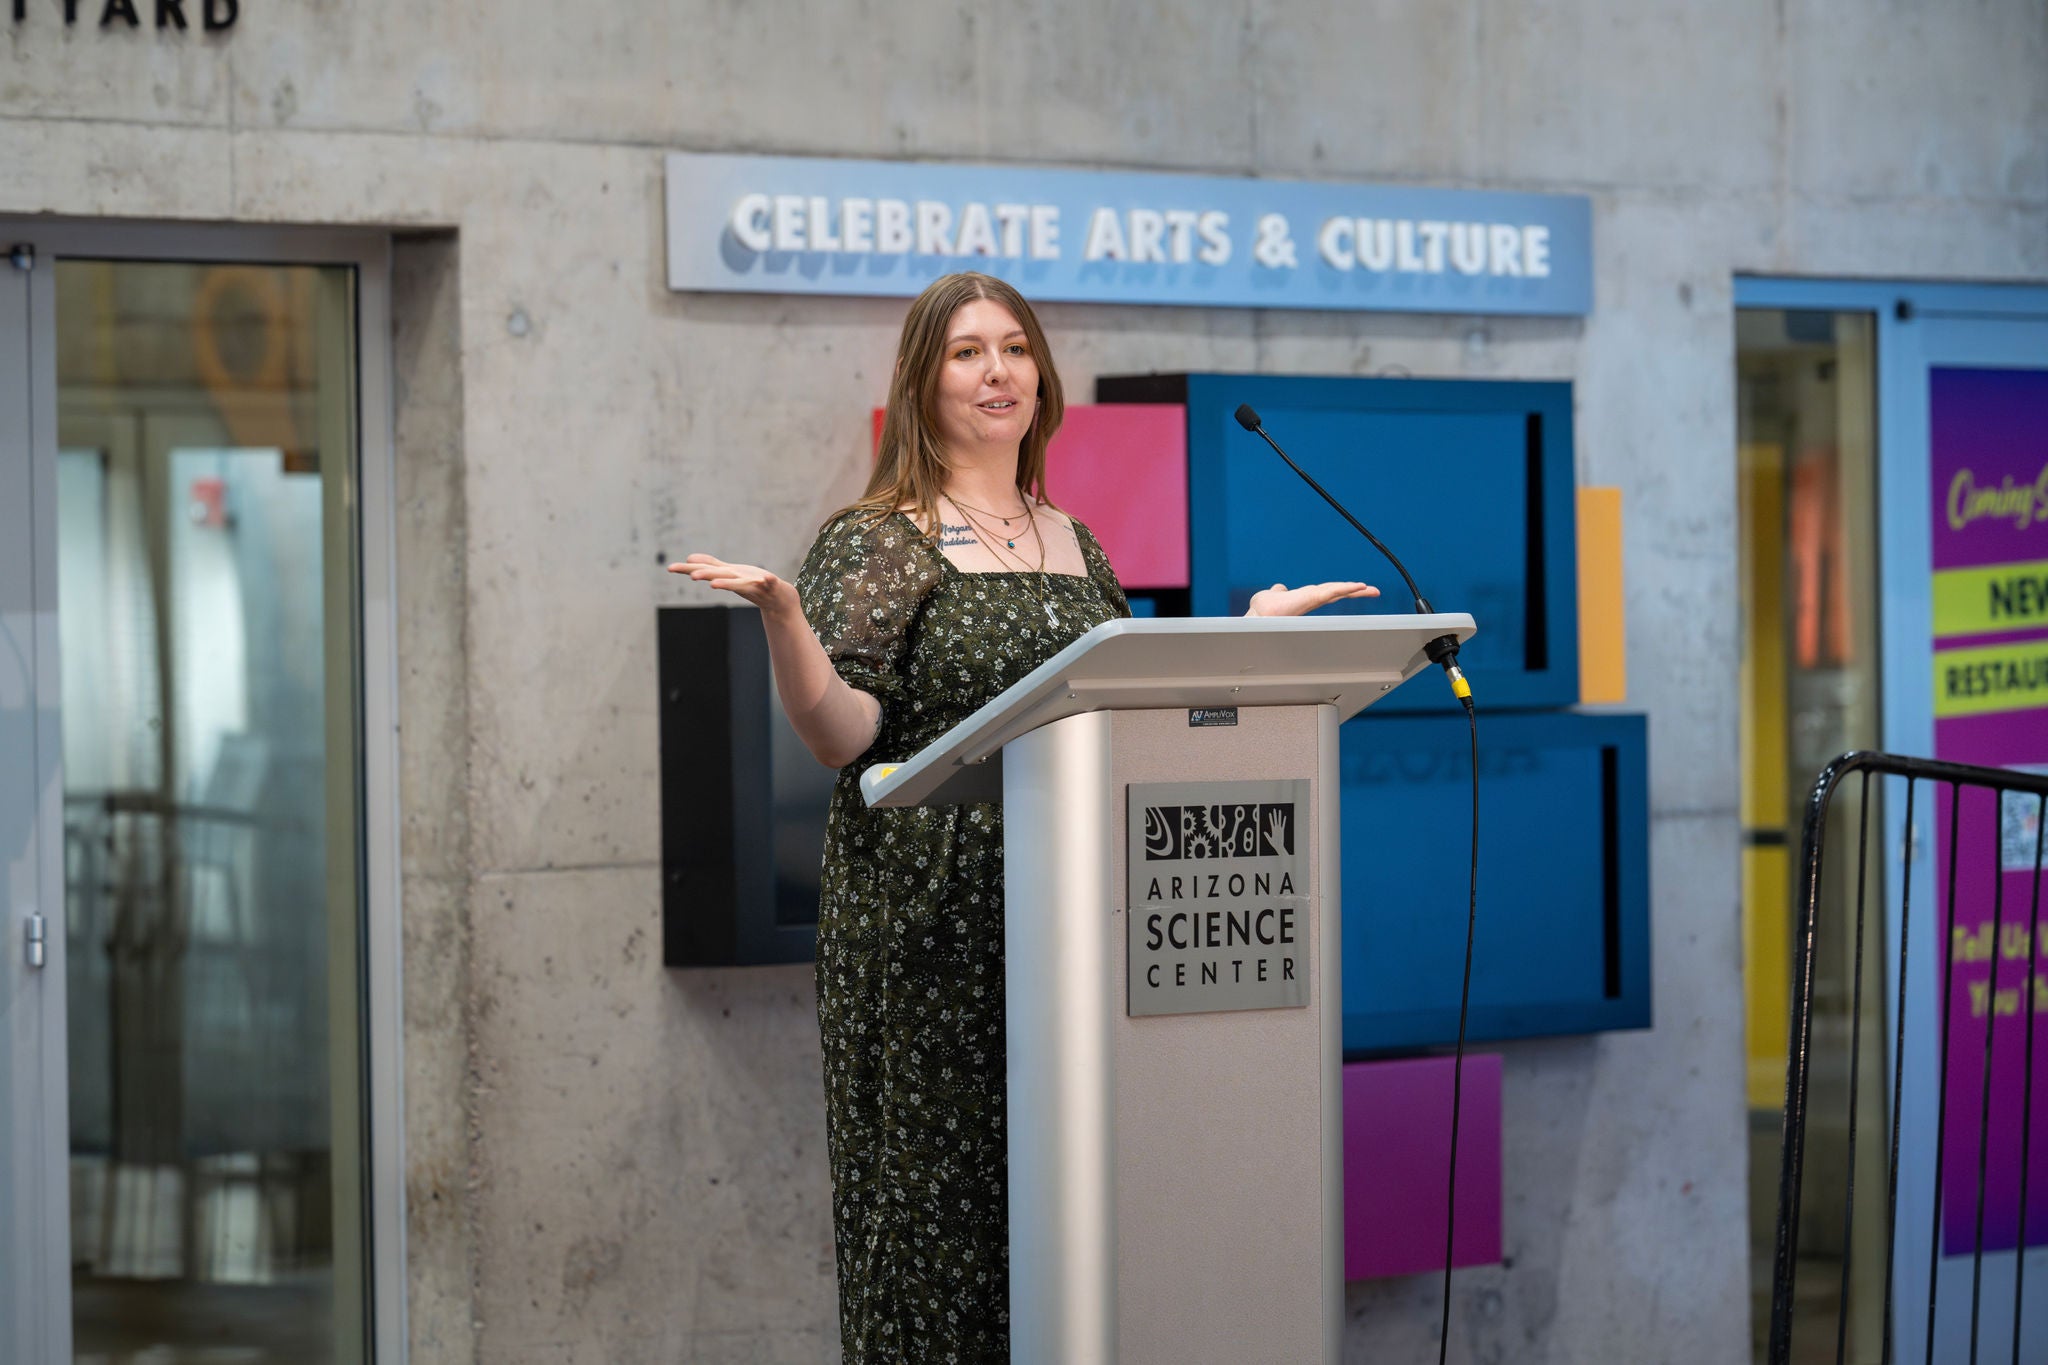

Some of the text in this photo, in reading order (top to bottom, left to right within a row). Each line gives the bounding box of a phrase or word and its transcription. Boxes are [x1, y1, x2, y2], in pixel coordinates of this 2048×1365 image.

[732, 193, 1551, 278] CELEBRATE ARTS & CULTURE
[1946, 656, 2048, 698] RESTAU
[1147, 872, 1295, 901] ARIZONA
[1146, 908, 1295, 951] SCIENCE
[1147, 957, 1295, 988] CENTER
